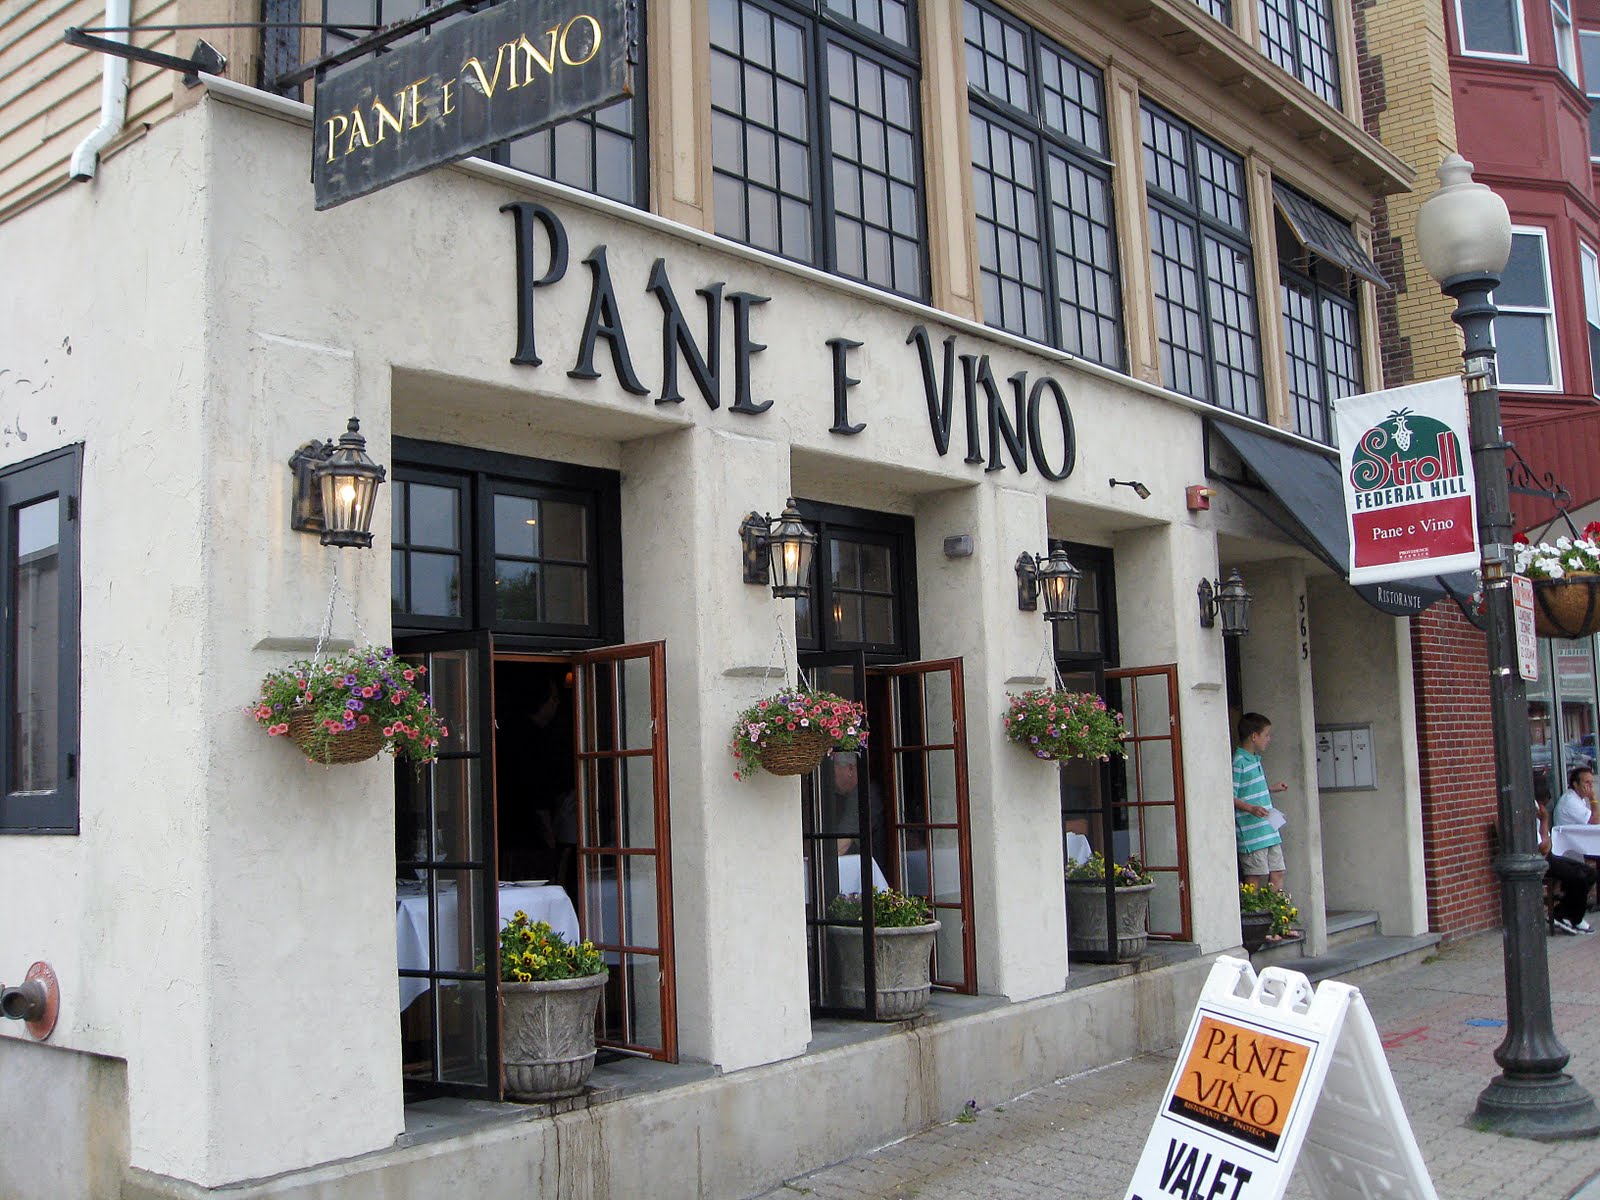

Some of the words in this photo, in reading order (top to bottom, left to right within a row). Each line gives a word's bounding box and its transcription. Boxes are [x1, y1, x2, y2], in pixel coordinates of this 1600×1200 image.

[325, 76, 432, 164] PANE
[441, 78, 456, 116] E
[461, 14, 601, 98] VINO
[500, 201, 775, 415] PANE
[825, 337, 866, 435] E
[906, 324, 1076, 482] VINO
[1350, 427, 1459, 492] Stroll
[1355, 486, 1424, 510] FEDERAL
[1431, 477, 1466, 498] HILL
[1372, 524, 1403, 541] Pane
[1408, 524, 1415, 535] e
[1419, 517, 1454, 533] Vino
[1377, 586, 1421, 609] RISTORANTE
[1202, 1027, 1296, 1083] PANE
[1189, 1071, 1278, 1126] VINO
[1158, 1138, 1253, 1200] VALET
